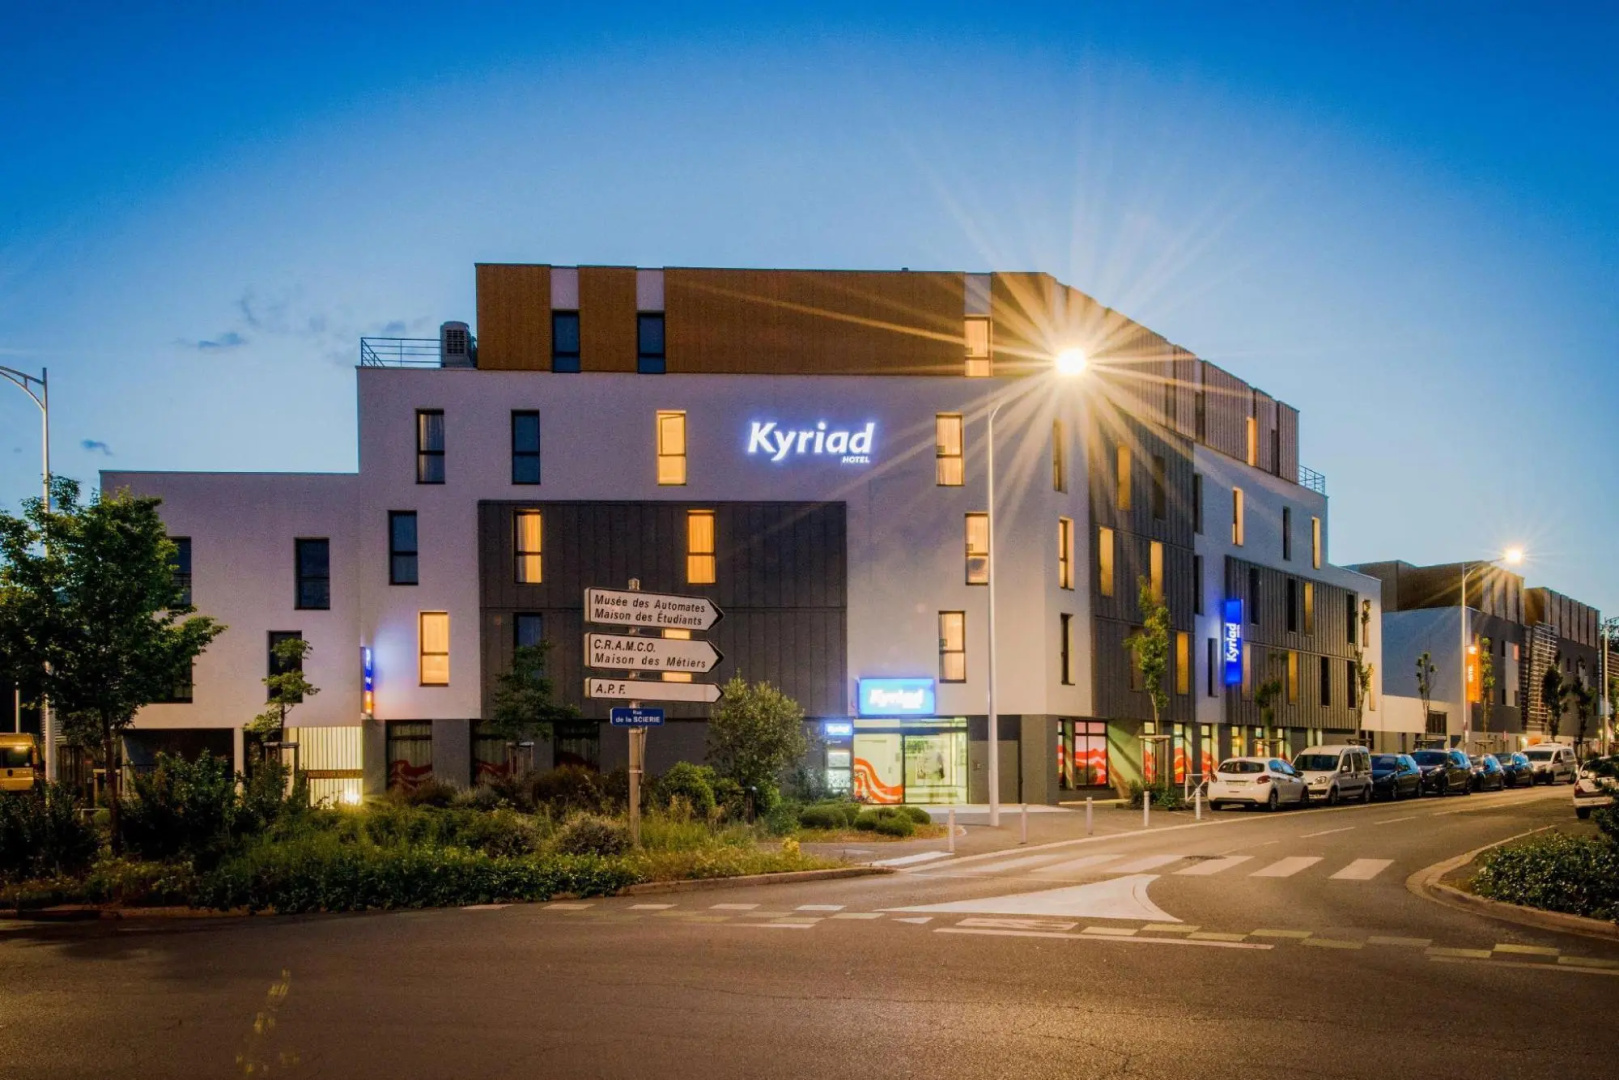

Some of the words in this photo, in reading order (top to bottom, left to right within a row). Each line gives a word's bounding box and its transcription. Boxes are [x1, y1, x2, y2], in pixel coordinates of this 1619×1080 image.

[748, 421, 875, 461] Kyriad
[594, 594, 628, 606] Musée
[632, 598, 649, 608] des
[654, 600, 706, 613] Automates
[594, 608, 631, 621] Maison
[635, 611, 652, 622] des
[657, 610, 702, 625] Étudiants
[594, 639, 656, 652] C.R.A.M.C.O.
[1226, 623, 1239, 662] Kyriad
[594, 653, 634, 665] Maison
[641, 655, 659, 666] des
[666, 656, 706, 669] Métiers
